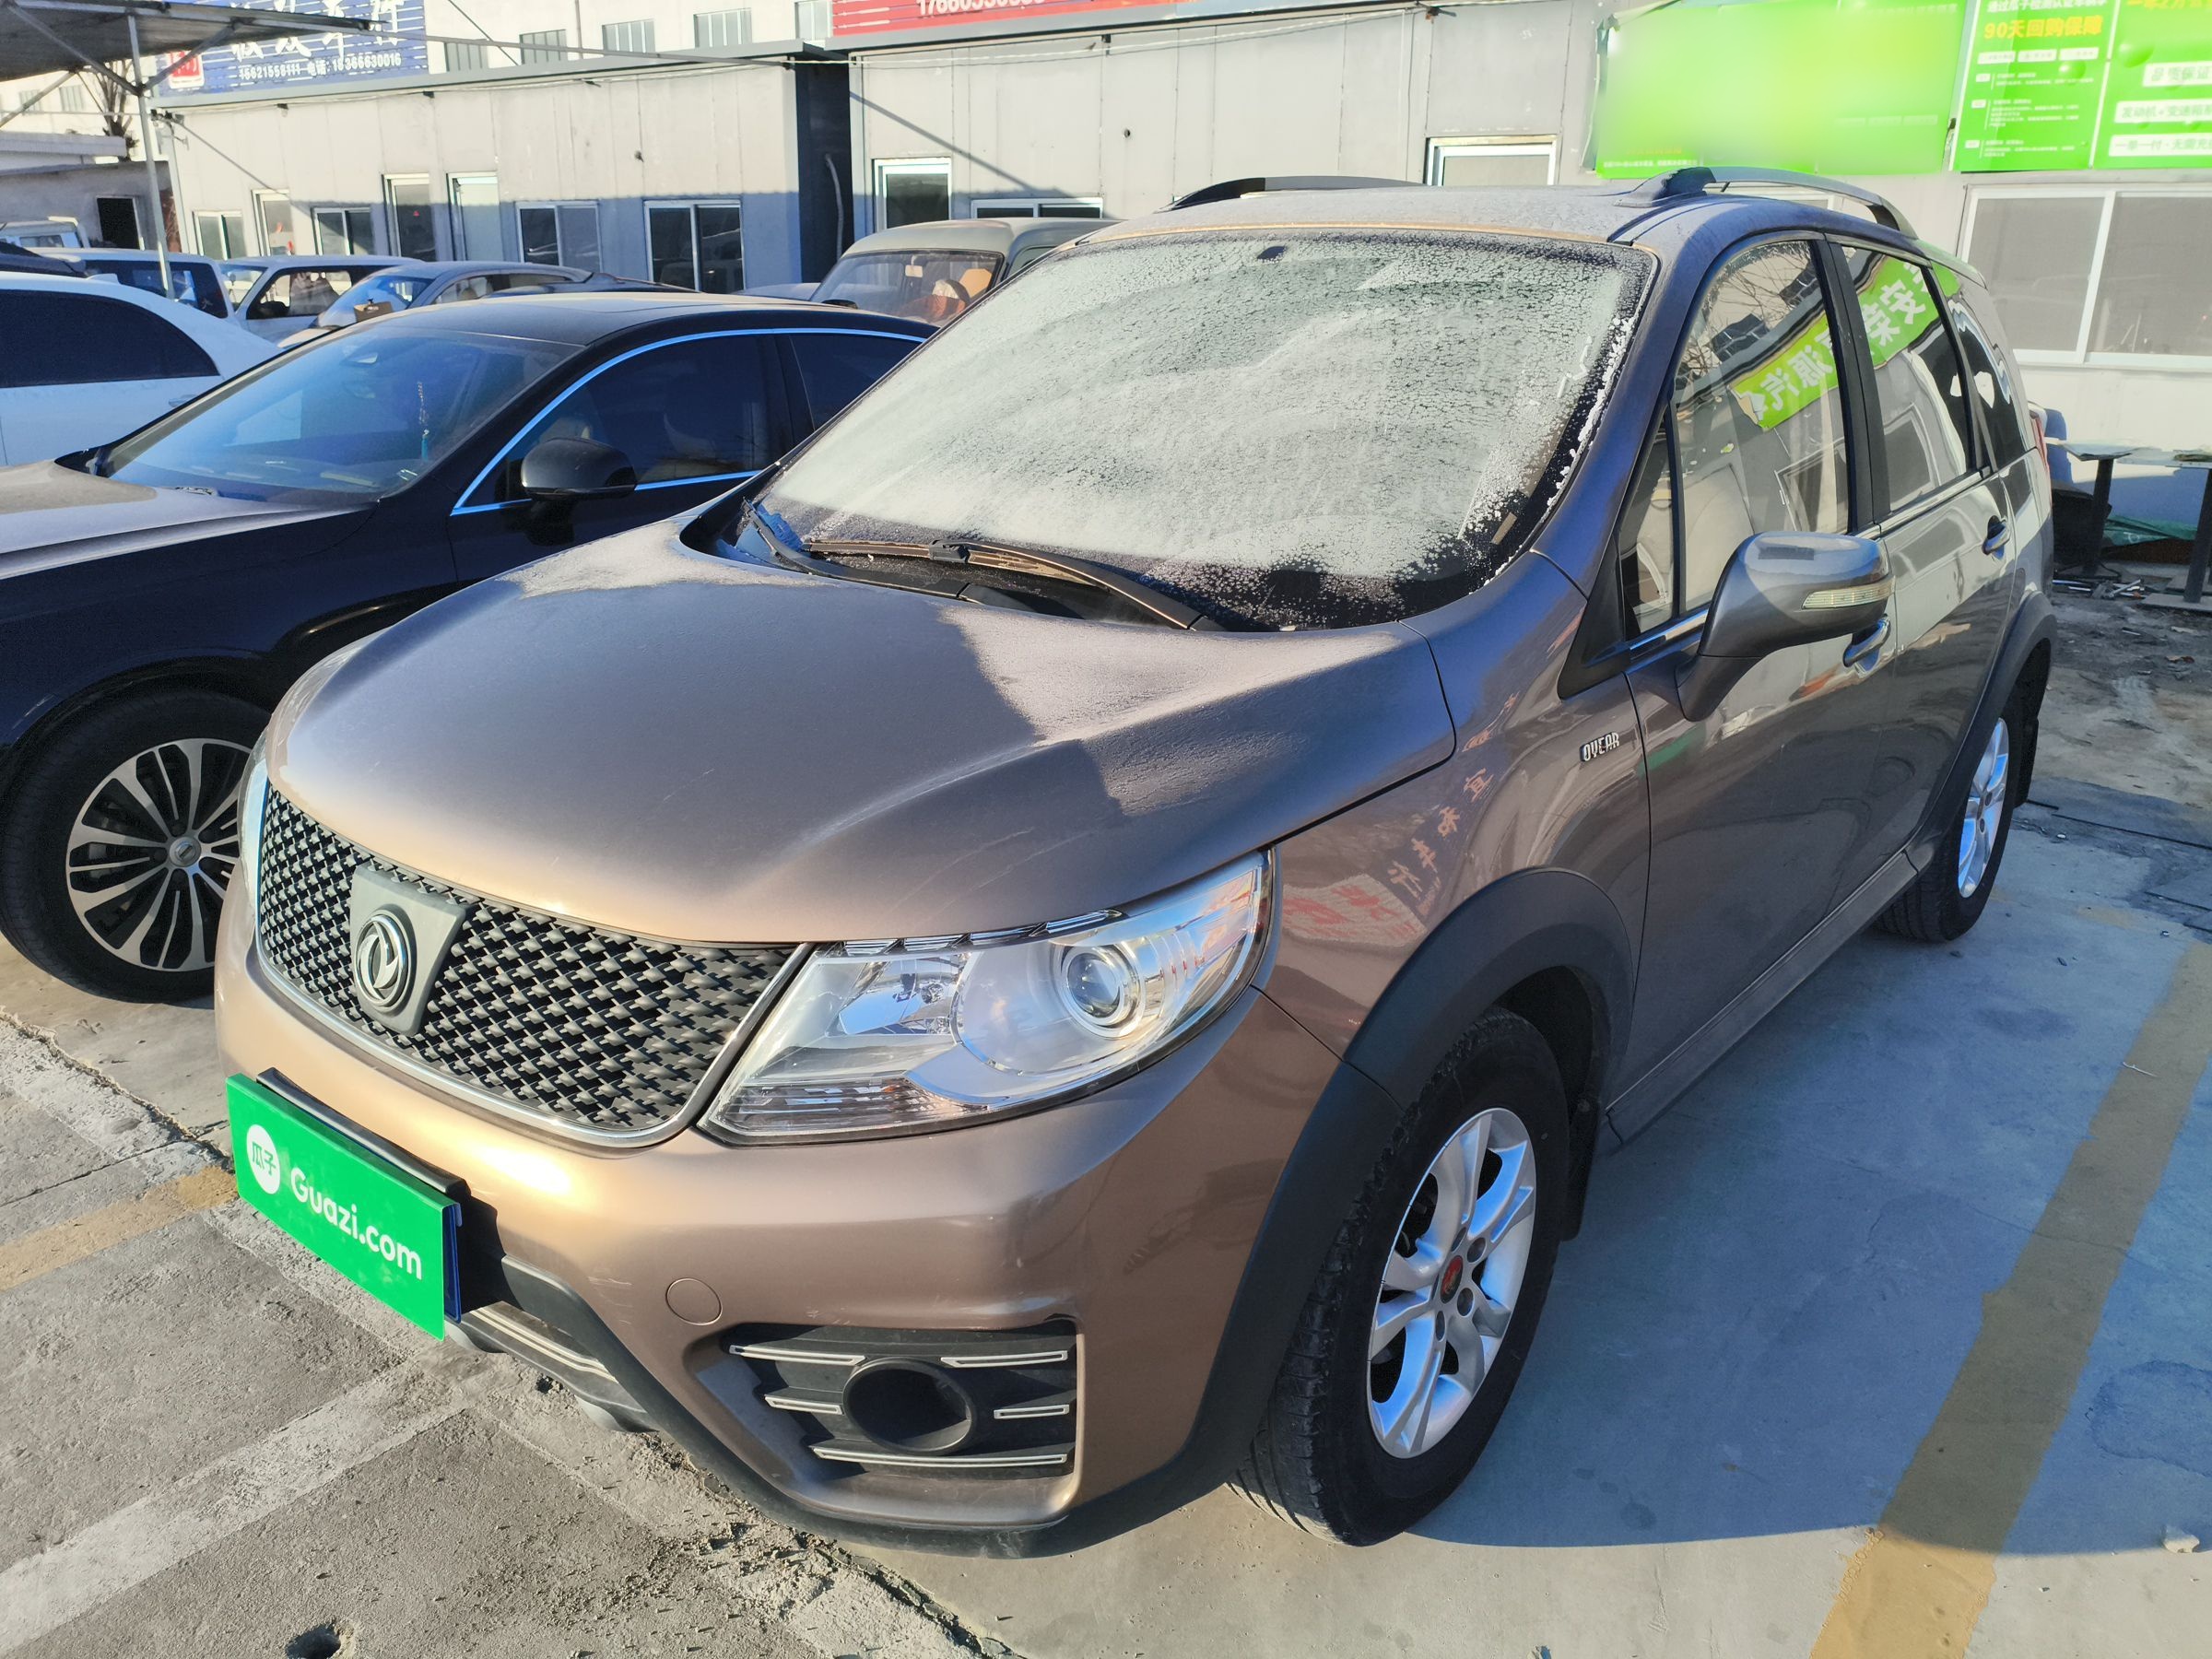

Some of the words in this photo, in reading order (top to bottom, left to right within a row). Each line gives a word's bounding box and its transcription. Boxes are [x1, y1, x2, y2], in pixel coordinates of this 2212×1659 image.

[1983, 15, 2103, 39] 90天回购保障
[251, 1141, 276, 1176] 瓜子
[290, 1168, 423, 1280] Guazi.com
